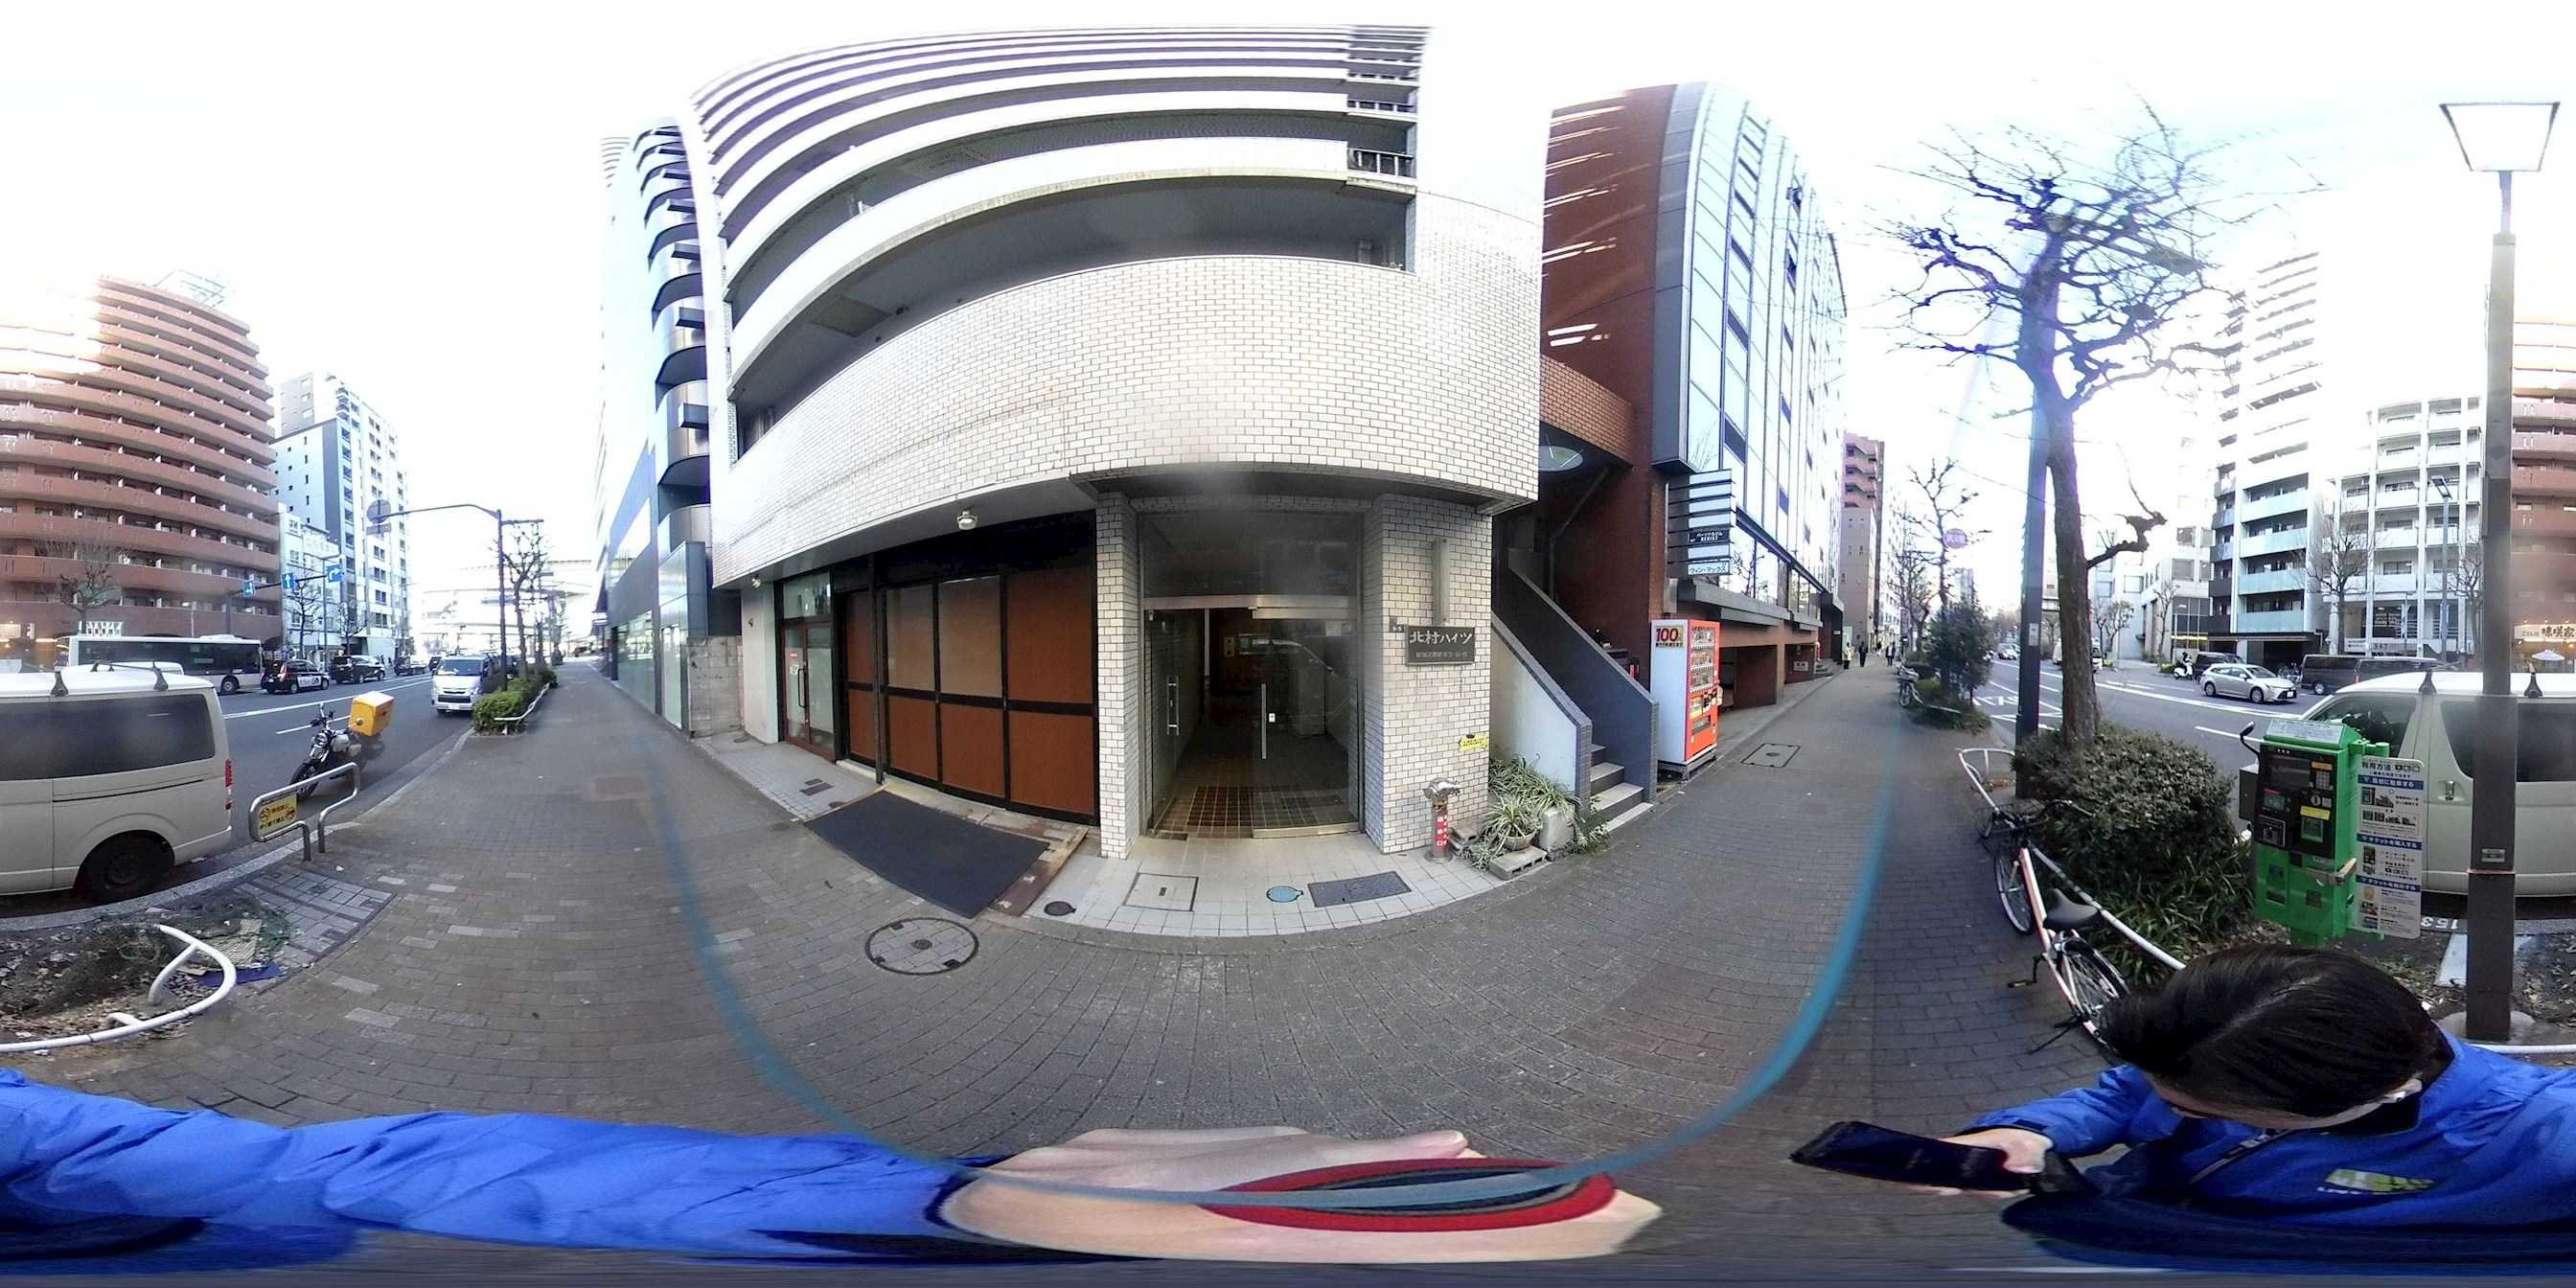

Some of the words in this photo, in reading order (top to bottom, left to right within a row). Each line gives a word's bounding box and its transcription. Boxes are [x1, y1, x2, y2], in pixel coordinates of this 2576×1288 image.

[1409, 630, 1473, 645] 北村ハイツ
[1655, 628, 1679, 642] 100
[2421, 916, 2458, 930] 153
